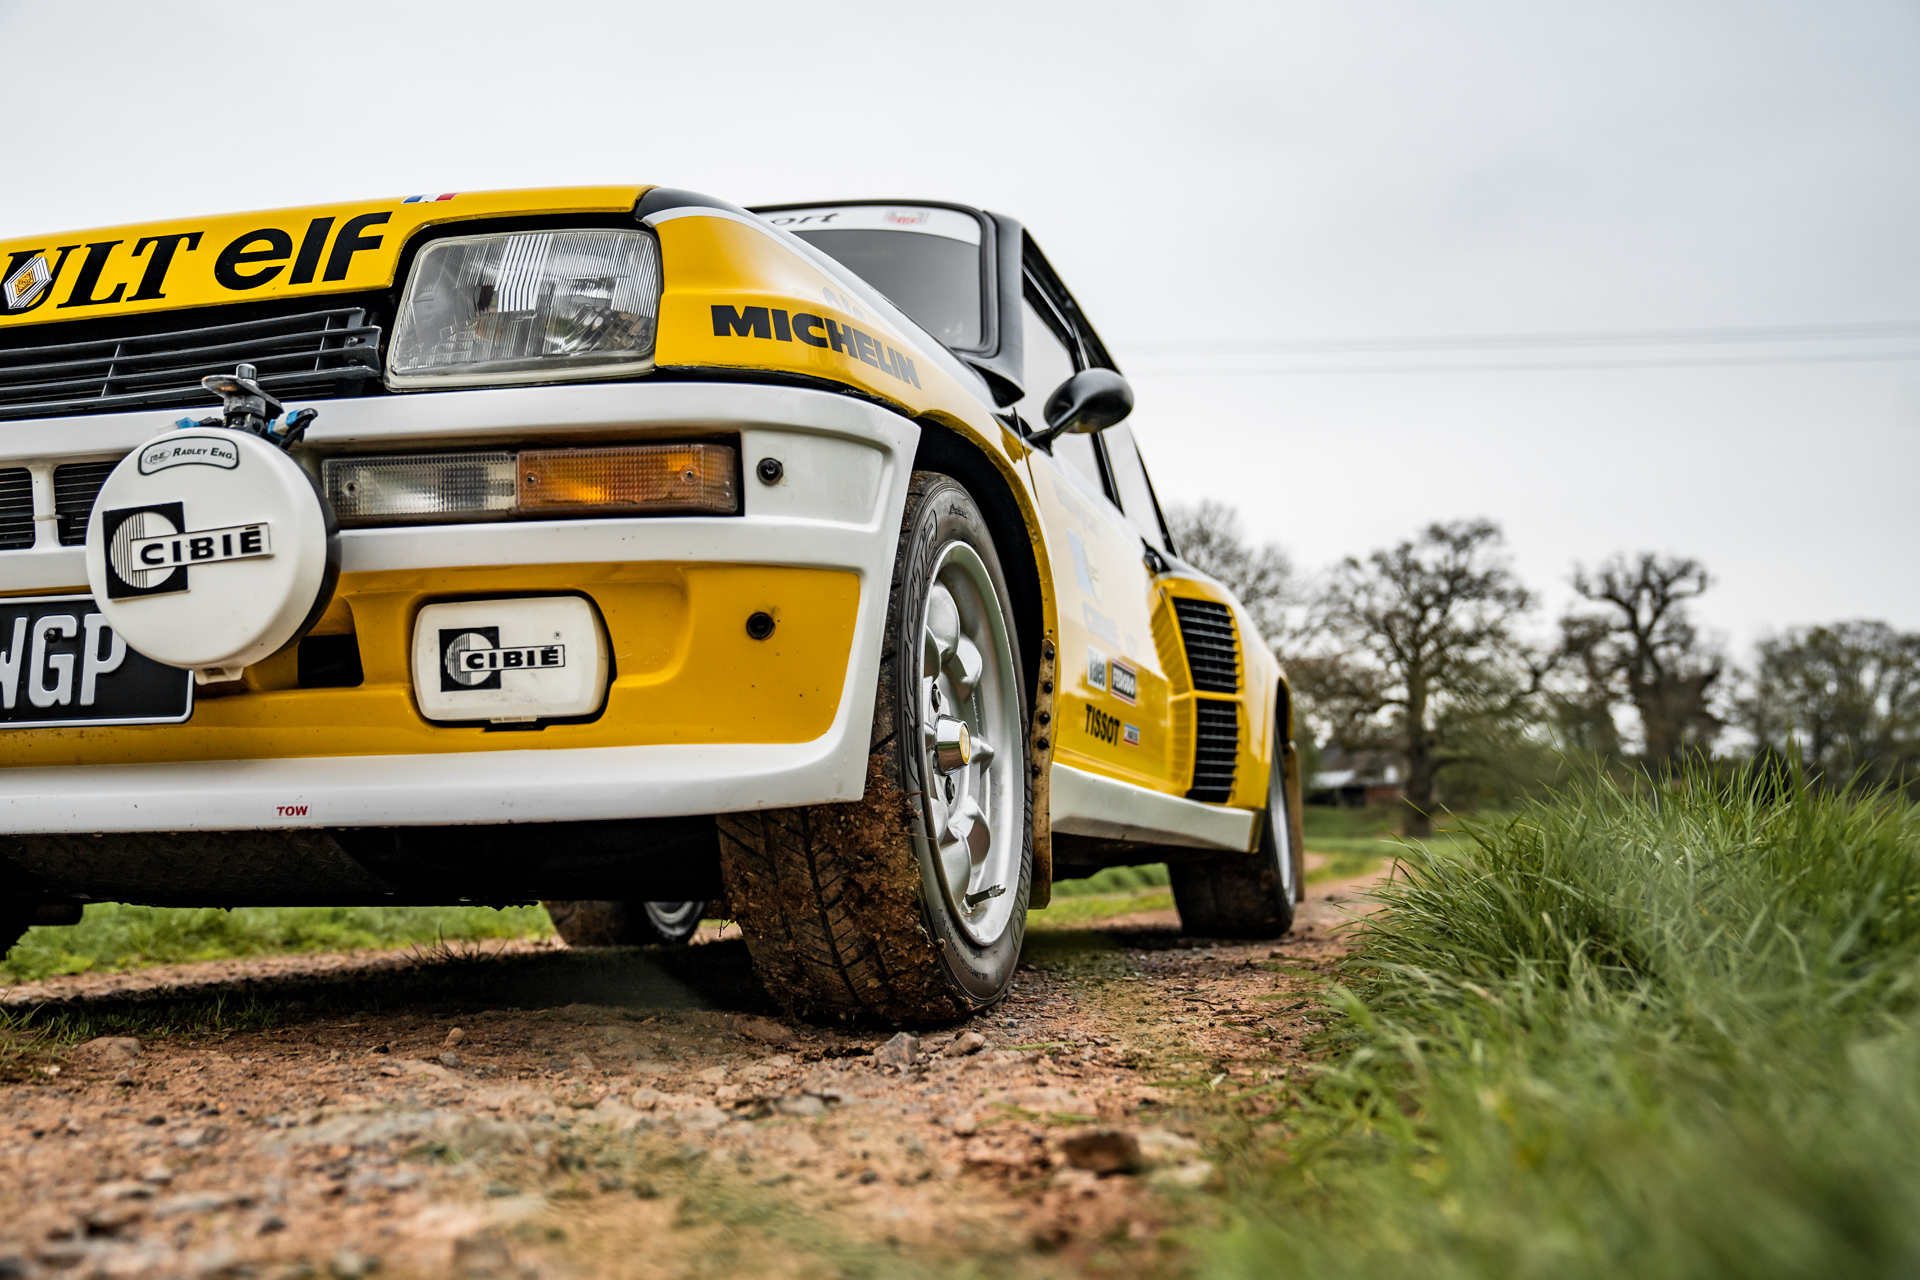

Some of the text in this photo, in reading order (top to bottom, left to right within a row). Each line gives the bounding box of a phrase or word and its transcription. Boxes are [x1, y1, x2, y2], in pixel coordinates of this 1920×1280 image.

[214, 211, 393, 291] elf
[711, 305, 922, 390] MICHELIN
[1085, 703, 1120, 746] TISSOT
[276, 805, 308, 817] TOW
